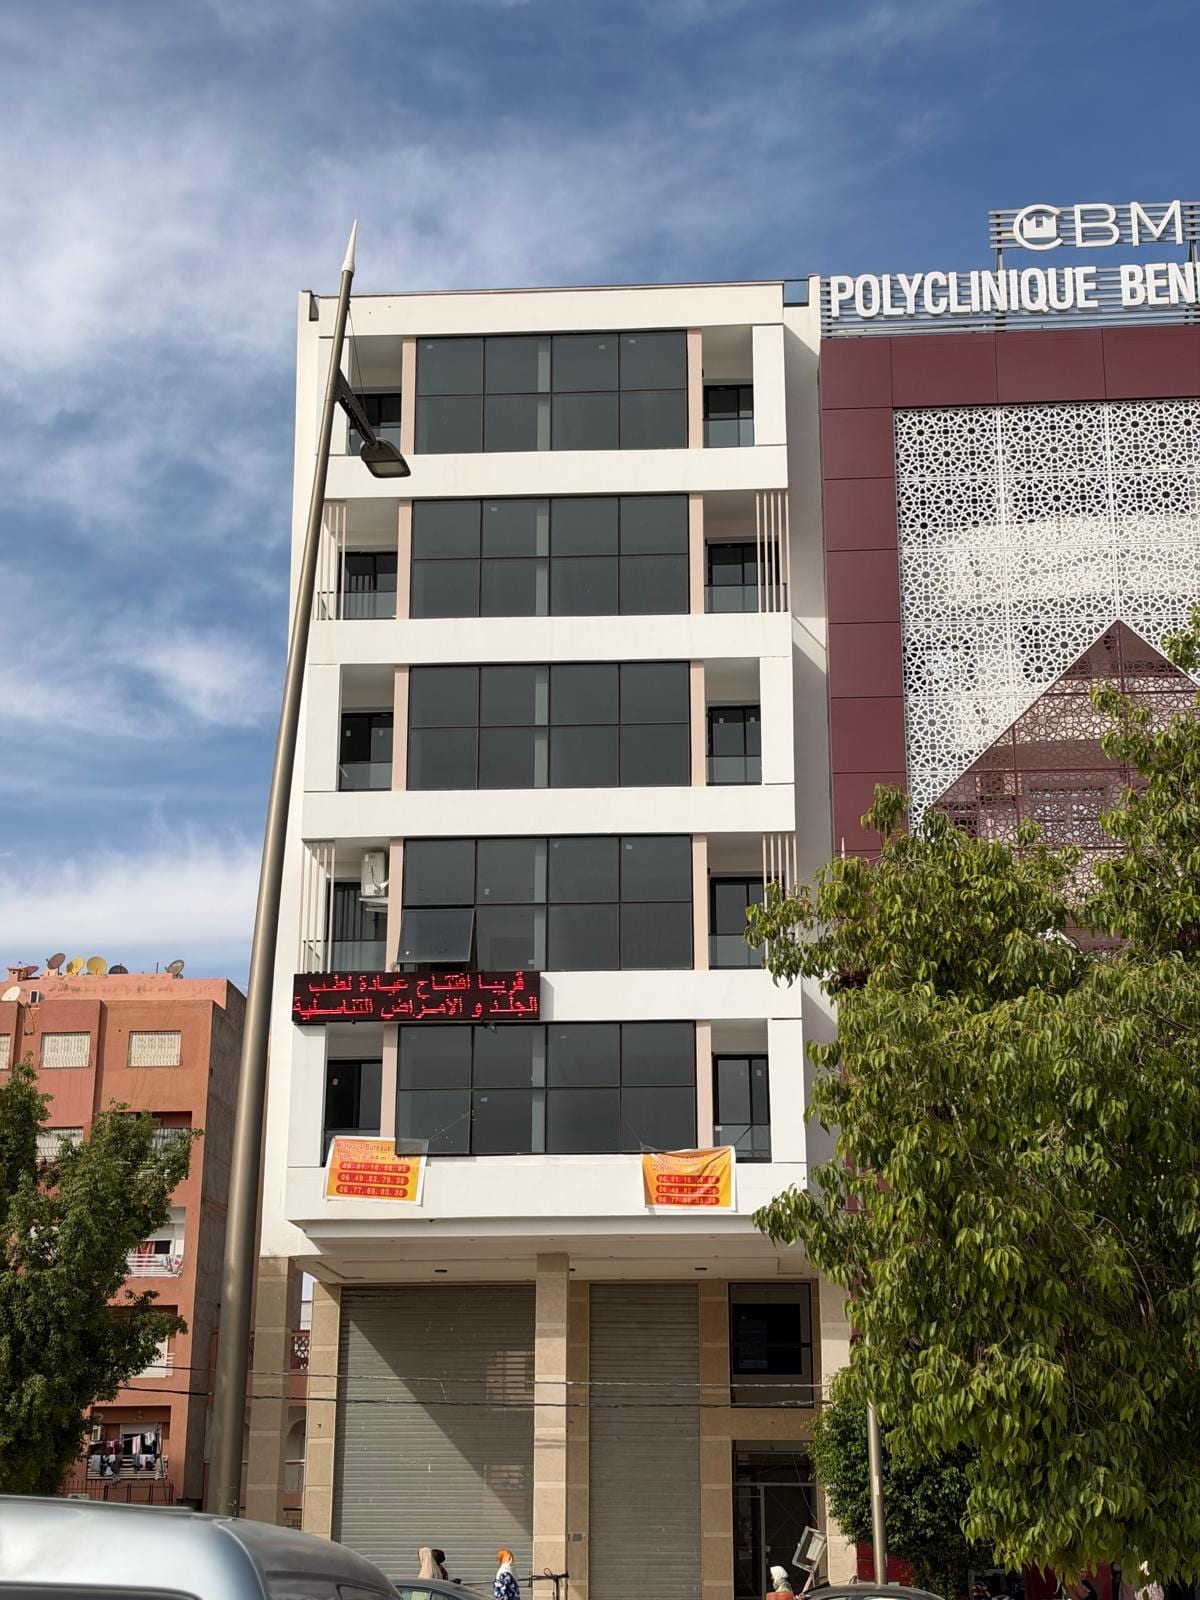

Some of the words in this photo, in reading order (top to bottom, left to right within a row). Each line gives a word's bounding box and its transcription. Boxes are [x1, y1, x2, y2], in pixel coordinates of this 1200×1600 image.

[1013, 199, 1183, 251] CBM
[830, 267, 1098, 319] POLYCLINIQUE
[1120, 262, 1200, 308] BEN
[309, 974, 352, 997] لطب
[358, 975, 409, 996] عيادة
[478, 970, 525, 996] قريبا
[292, 996, 373, 1020] التناسلية
[471, 1002, 483, 1018] و
[489, 994, 538, 1017] الجلد
